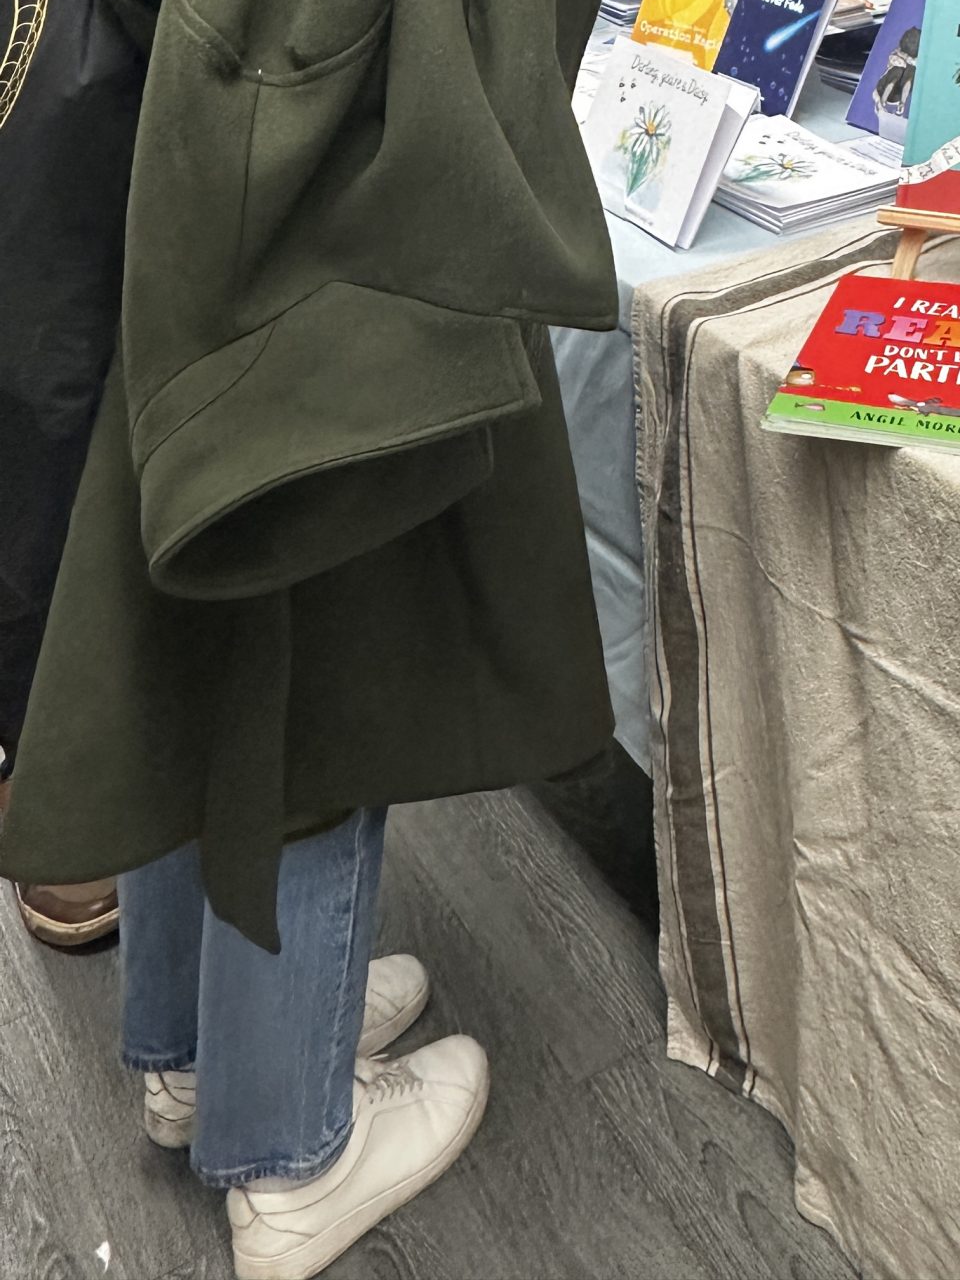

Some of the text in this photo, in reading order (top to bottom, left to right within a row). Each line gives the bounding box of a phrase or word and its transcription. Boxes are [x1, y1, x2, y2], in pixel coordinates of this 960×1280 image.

[893, 297, 906, 308] I
[883, 345, 950, 361] DON'T
[850, 410, 906, 427] ANGIE
